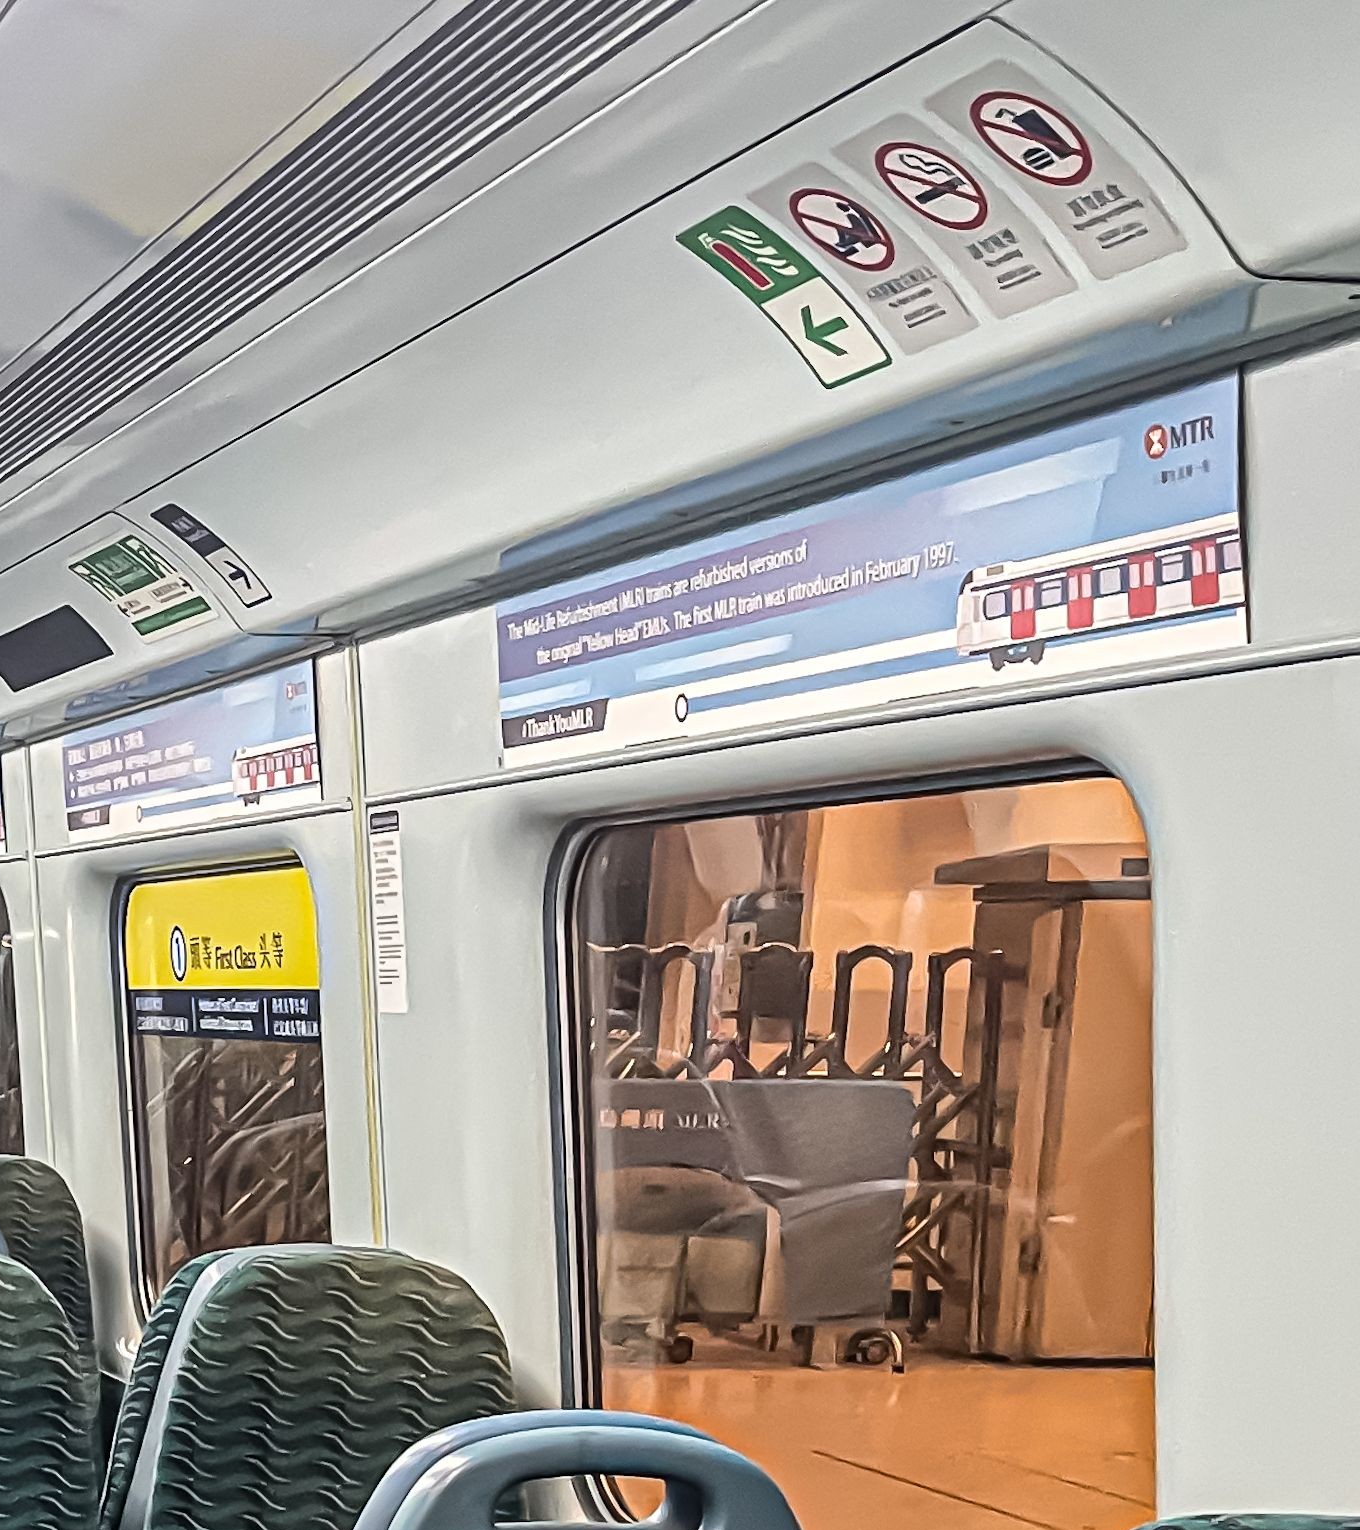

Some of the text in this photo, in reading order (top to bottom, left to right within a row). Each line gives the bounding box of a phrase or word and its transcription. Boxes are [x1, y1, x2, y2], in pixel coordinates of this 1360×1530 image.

[1170, 416, 1214, 449] MTR
[507, 622, 522, 640] The
[523, 612, 556, 637] Mid-Life
[619, 586, 645, 612] (MLR)
[646, 581, 672, 603] trains
[672, 579, 688, 597] are
[690, 556, 747, 592] refurbished
[749, 548, 792, 575] versions
[795, 538, 808, 564] of
[536, 648, 551, 665] the
[551, 637, 582, 664] original
[673, 611, 691, 630] The
[692, 605, 713, 626] first
[738, 592, 762, 616] train
[764, 586, 785, 607] was
[787, 565, 850, 602] introduced
[850, 563, 864, 585] in
[865, 553, 921, 584] February
[923, 540, 959, 569] 1997.
[216, 946, 234, 970] First
